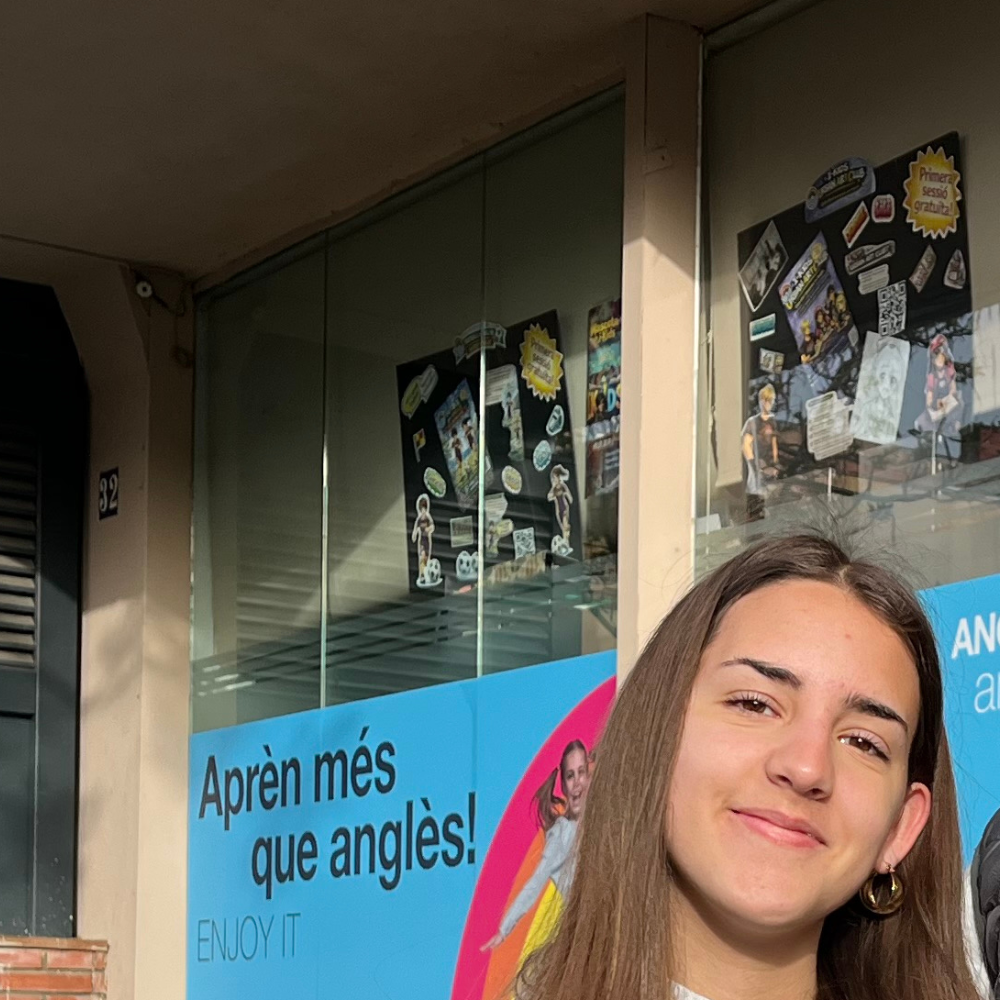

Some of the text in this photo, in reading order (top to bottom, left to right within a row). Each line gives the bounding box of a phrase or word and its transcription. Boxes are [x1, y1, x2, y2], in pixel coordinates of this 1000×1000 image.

[920, 166, 953, 184] Primera
[922, 186, 948, 199] sessió
[100, 474, 118, 511] 32
[199, 726, 396, 831] Aprèn més
[252, 792, 476, 900] que anglès!
[197, 912, 302, 962] ENJOY IT
